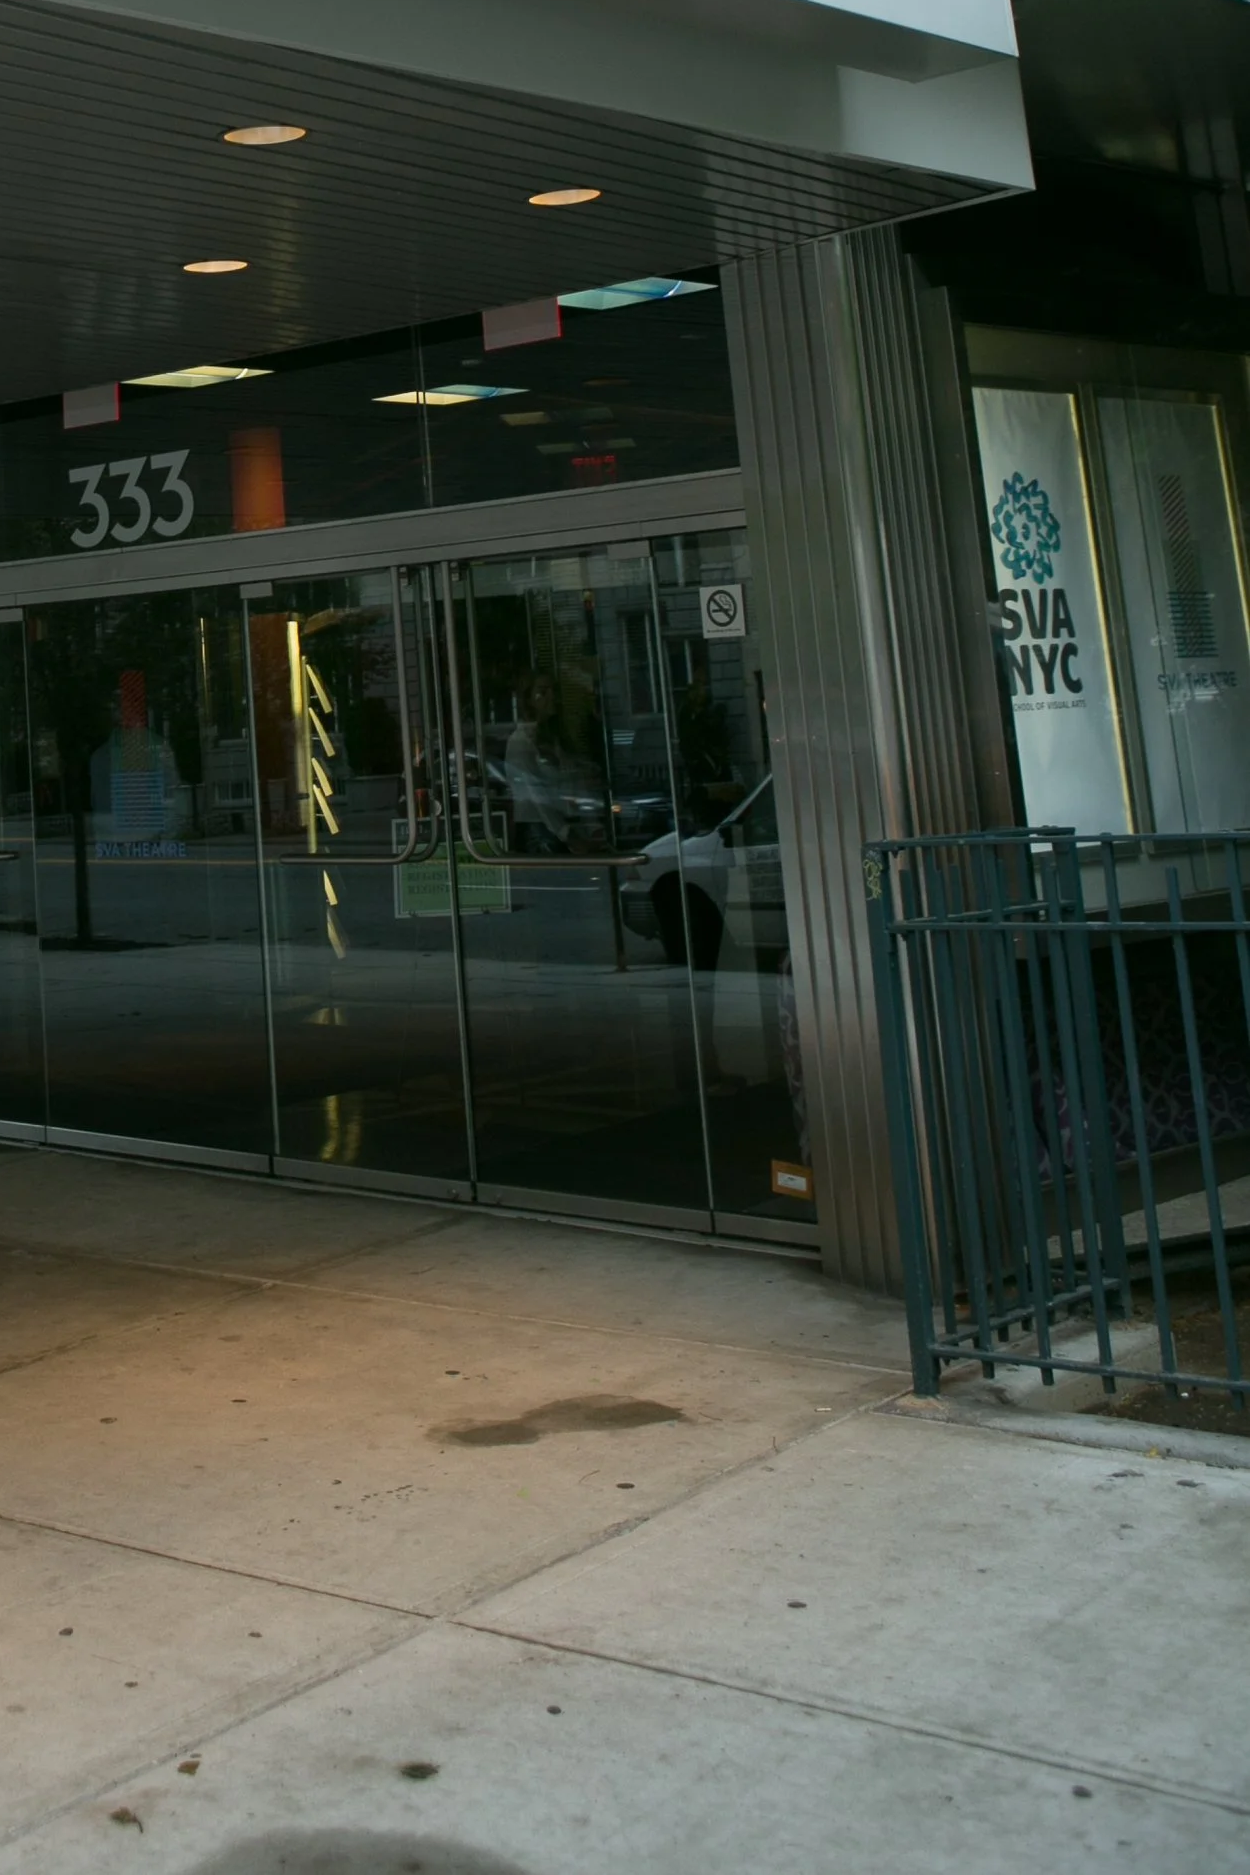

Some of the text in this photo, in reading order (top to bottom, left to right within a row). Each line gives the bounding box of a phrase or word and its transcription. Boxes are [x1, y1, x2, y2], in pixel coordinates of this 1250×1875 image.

[69, 449, 194, 548] 333
[999, 588, 1077, 641] SVA
[1005, 642, 1083, 696] NYC
[1014, 702, 1035, 712] CHOOL
[94, 841, 187, 858] SVA THEATRE
